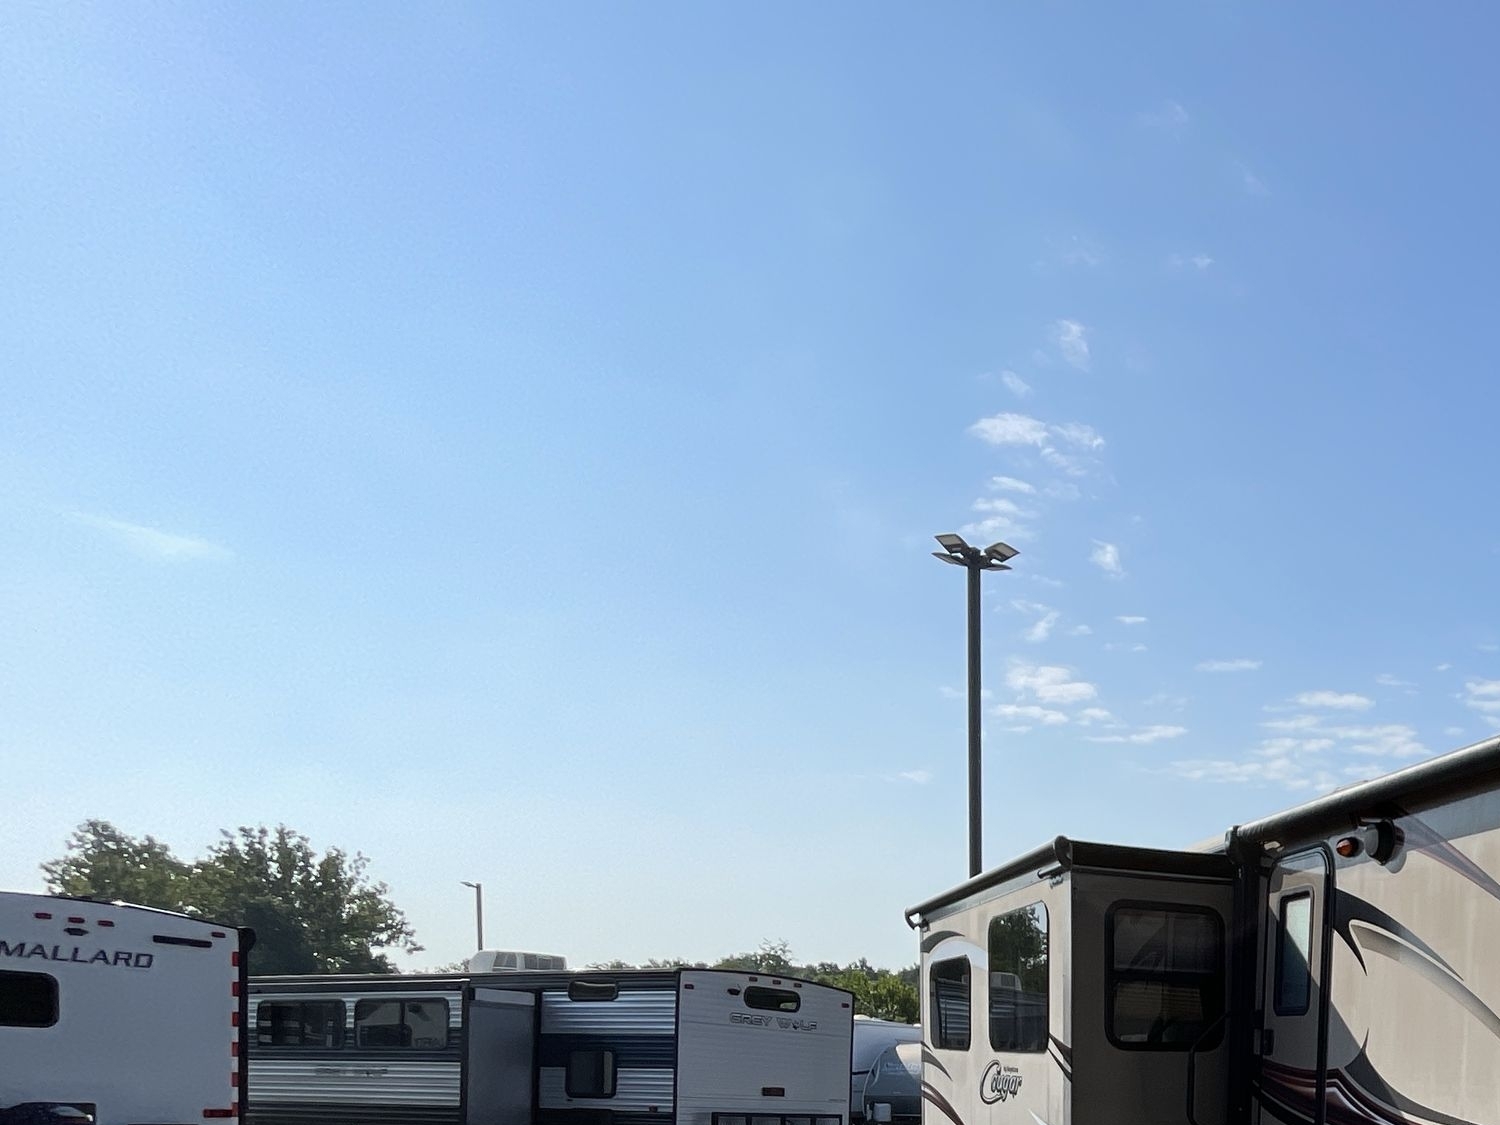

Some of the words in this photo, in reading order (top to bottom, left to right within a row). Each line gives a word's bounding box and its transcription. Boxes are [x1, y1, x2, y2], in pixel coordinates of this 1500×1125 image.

[0, 940, 154, 969] MALLARD
[729, 1011, 772, 1027] GREY
[980, 1059, 1022, 1105] Cougar
